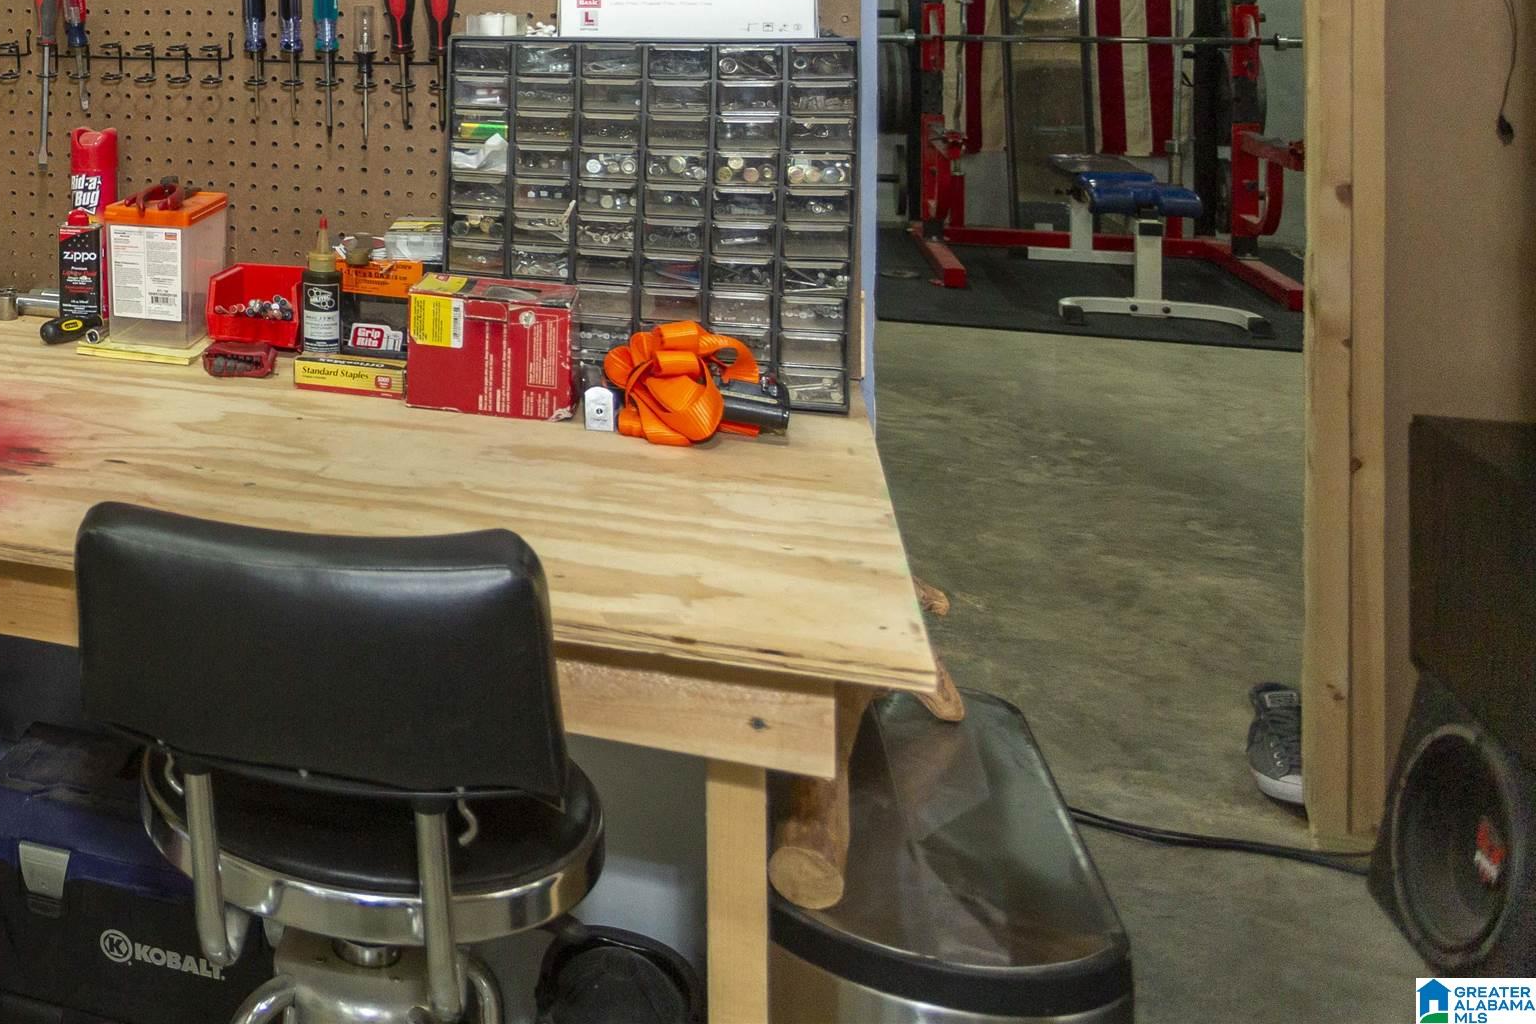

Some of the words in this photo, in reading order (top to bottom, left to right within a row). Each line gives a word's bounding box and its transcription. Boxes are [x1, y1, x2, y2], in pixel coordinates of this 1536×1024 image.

[584, 11, 594, 23] L
[75, 187, 100, 209] Bug
[357, 327, 381, 340] Grip
[356, 337, 379, 348] Rite
[302, 366, 340, 377] Standard
[340, 370, 369, 381] Staples
[134, 942, 224, 980] KOBALT
